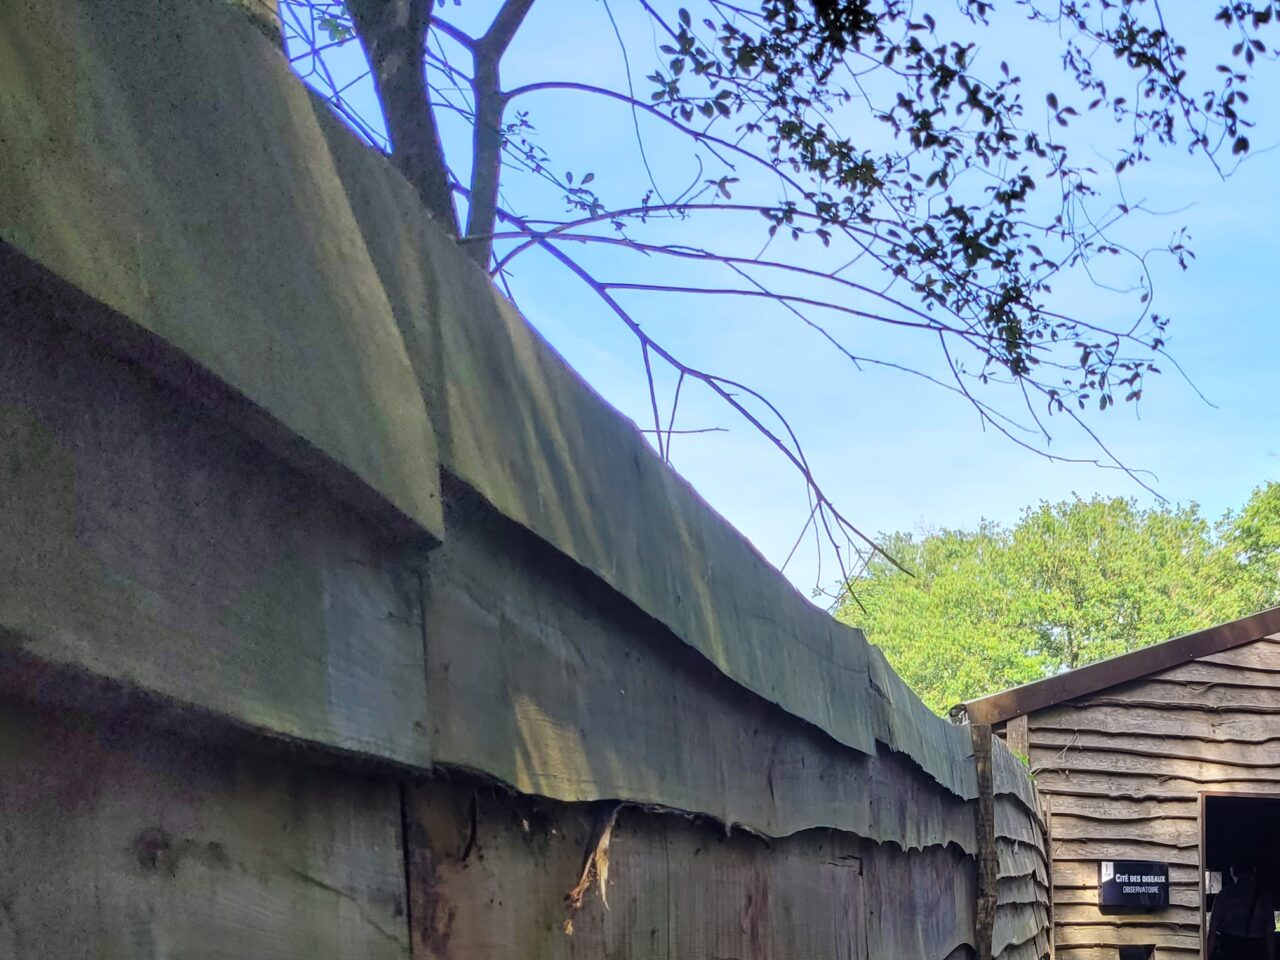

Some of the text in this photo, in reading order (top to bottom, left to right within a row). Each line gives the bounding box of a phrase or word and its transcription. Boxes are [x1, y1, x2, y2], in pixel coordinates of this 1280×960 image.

[1129, 875, 1141, 883] DES
[1141, 875, 1166, 883] OISEAUX
[1122, 885, 1160, 894] OBSERVATOIRE
